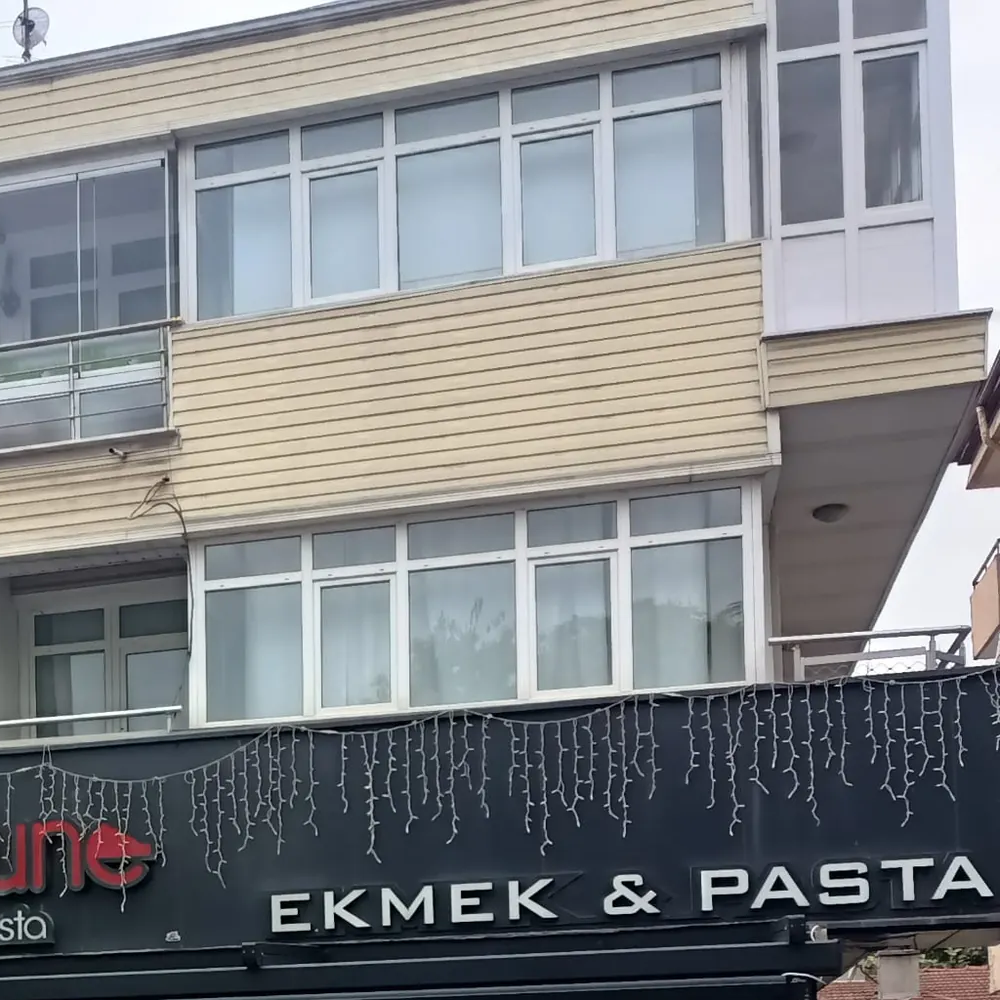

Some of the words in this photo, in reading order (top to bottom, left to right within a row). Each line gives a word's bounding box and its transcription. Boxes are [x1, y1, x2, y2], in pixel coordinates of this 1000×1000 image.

[270, 877, 559, 933] EKMEK
[603, 873, 661, 916] &
[700, 855, 995, 912] PASTA
